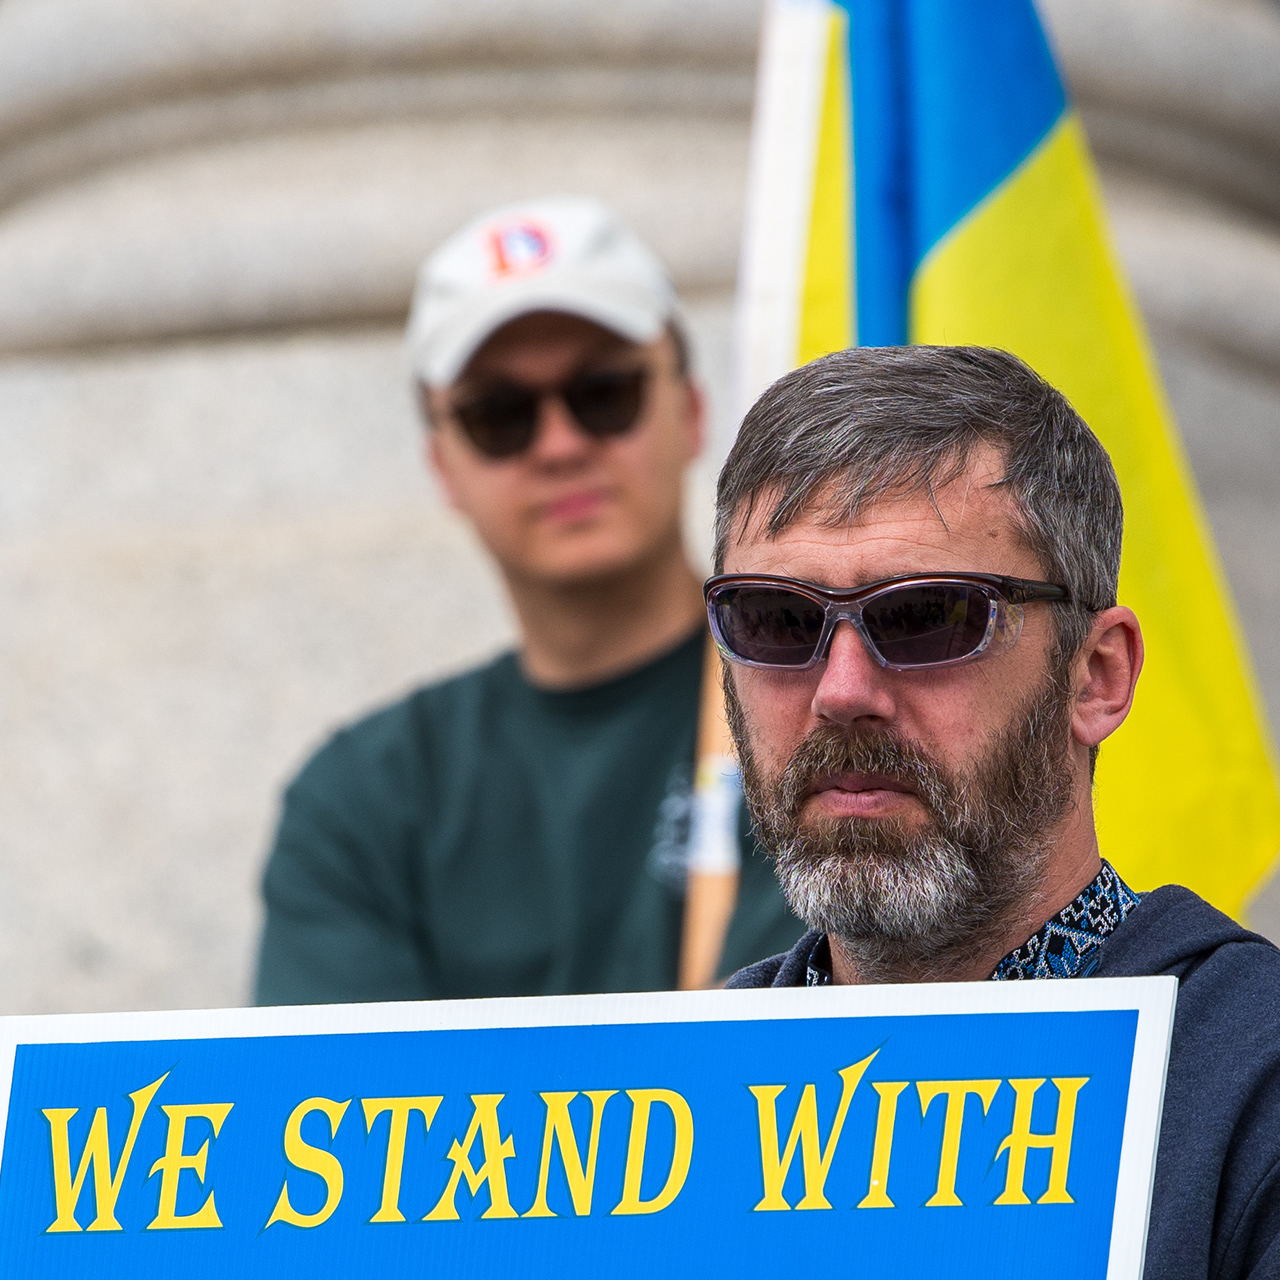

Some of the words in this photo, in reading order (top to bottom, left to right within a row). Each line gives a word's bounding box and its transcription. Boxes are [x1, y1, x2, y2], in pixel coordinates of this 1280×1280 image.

[41, 1068, 233, 1234] WE
[259, 1087, 695, 1238] STAND
[747, 1045, 1090, 1212] WITH
